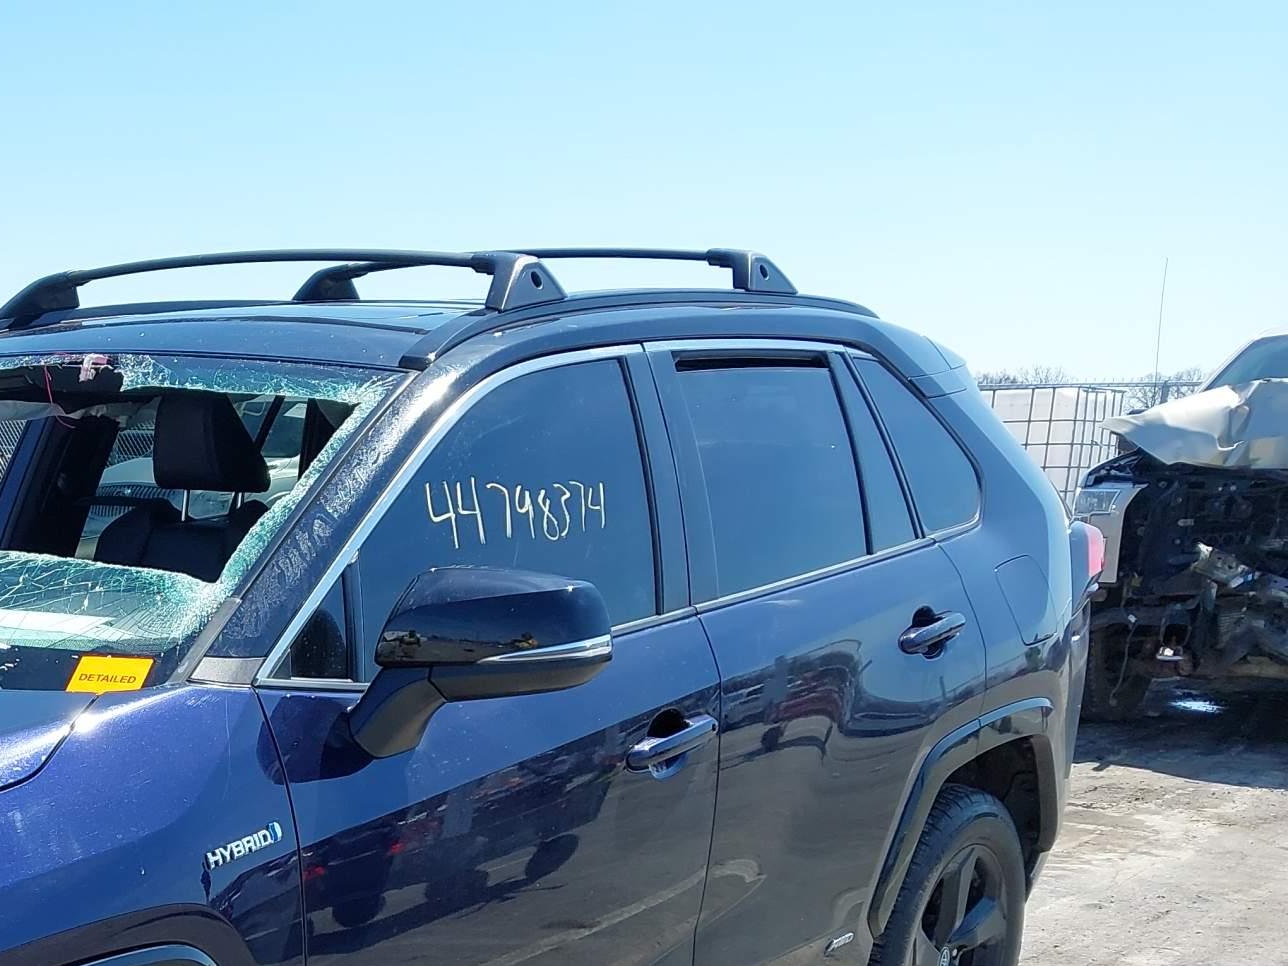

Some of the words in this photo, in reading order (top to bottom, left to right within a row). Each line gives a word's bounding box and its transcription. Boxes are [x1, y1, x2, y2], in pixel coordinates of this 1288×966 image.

[425, 476, 606, 549] 44798374
[78, 673, 137, 684] DETAILED
[206, 829, 274, 870] HYBRID
